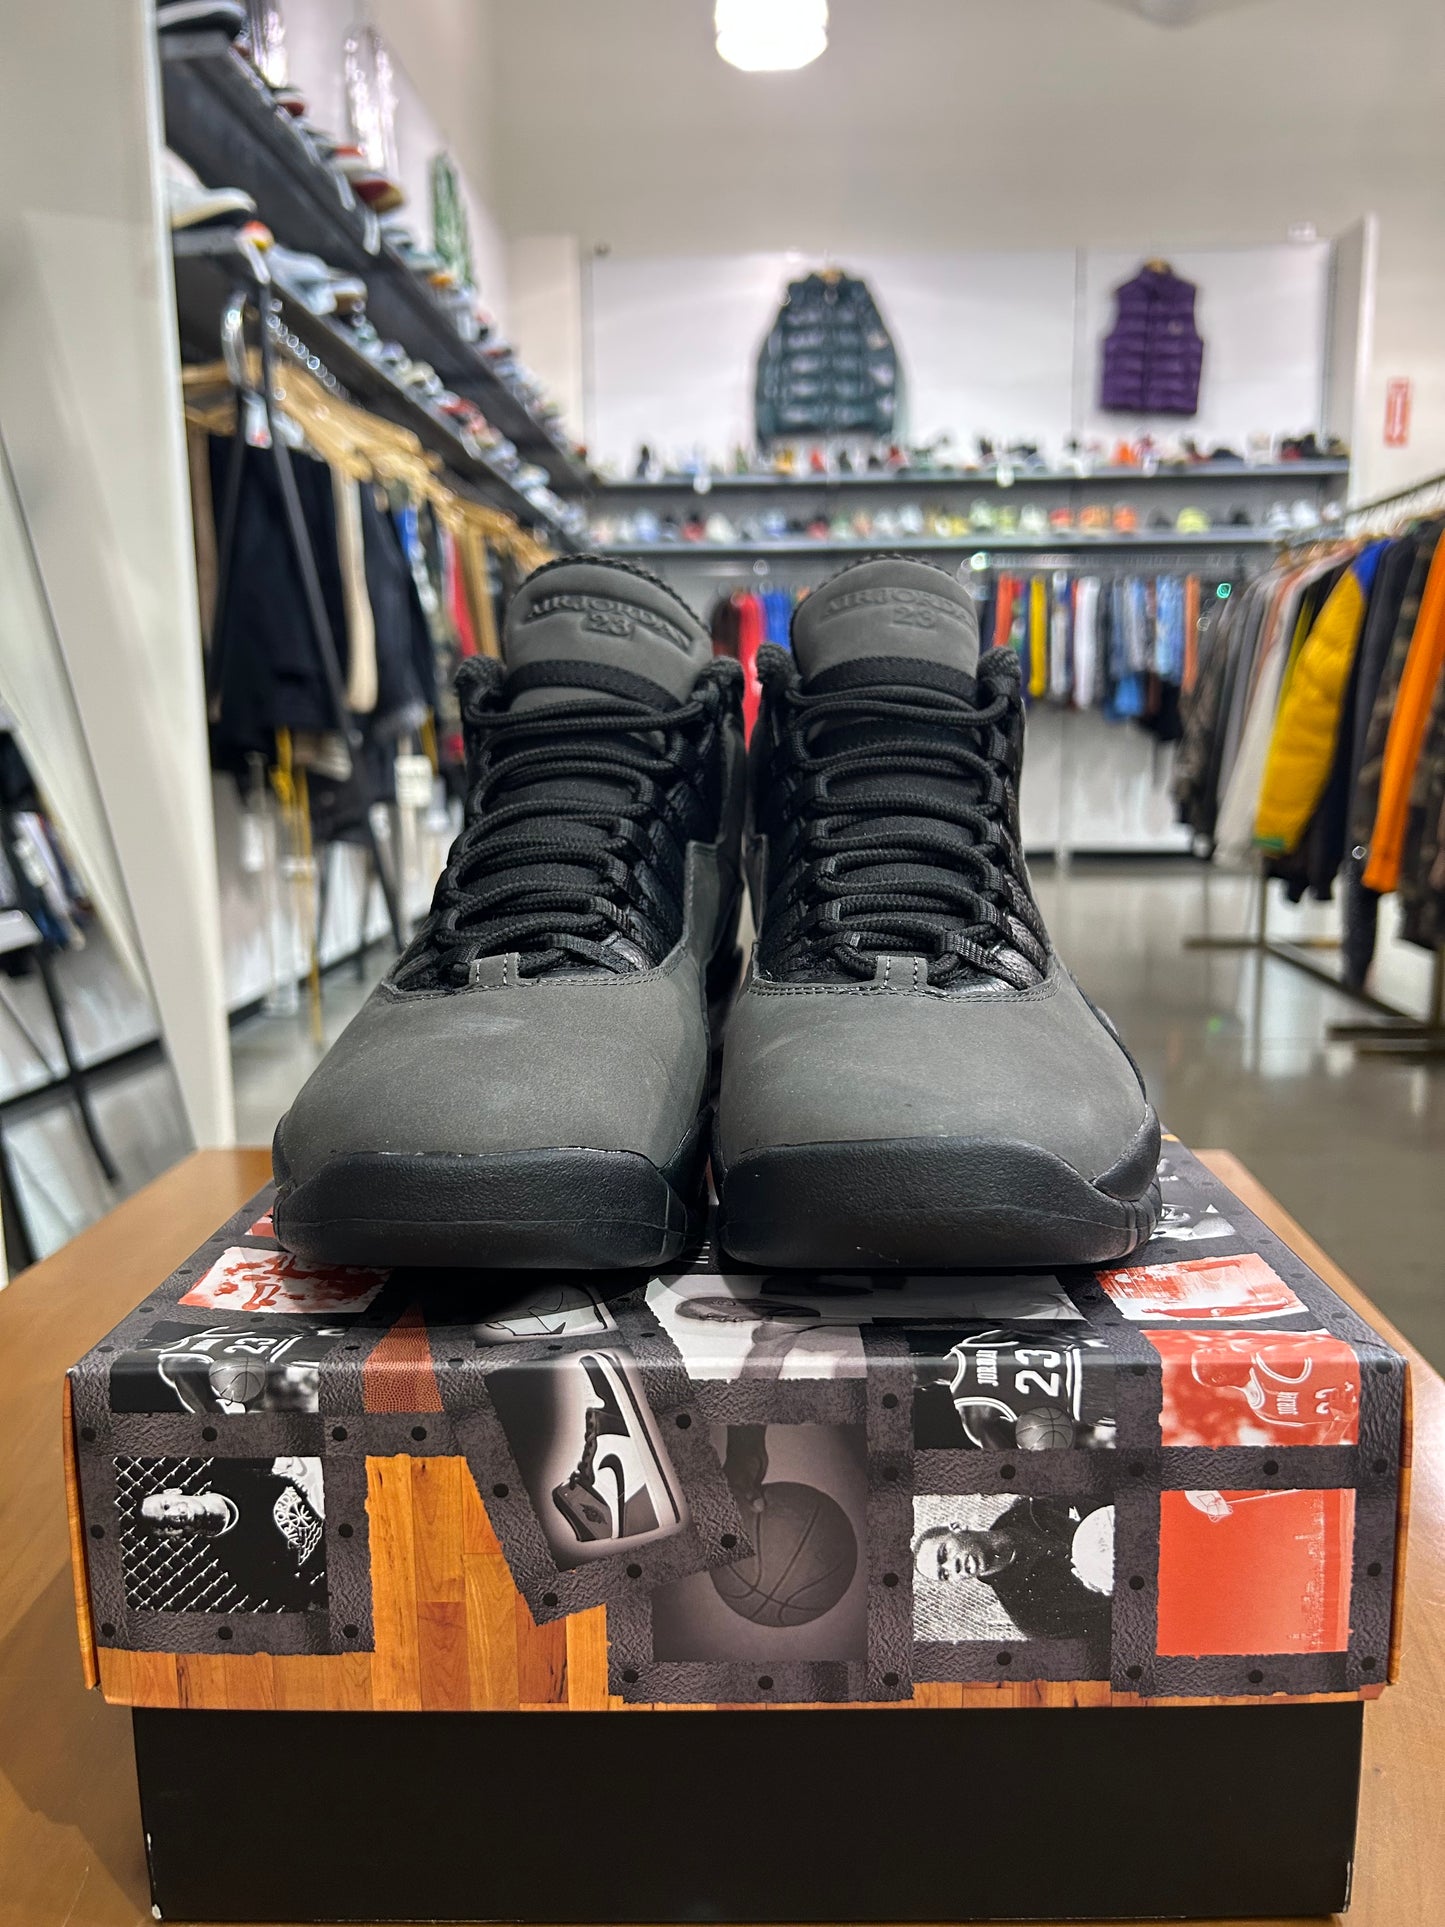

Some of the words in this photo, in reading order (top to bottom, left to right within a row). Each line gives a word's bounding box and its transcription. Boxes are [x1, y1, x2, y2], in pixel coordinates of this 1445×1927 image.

[588, 612, 631, 636] 23
[893, 606, 936, 629] 23
[223, 1337, 278, 1354] 23
[1014, 1349, 1061, 1397] 23
